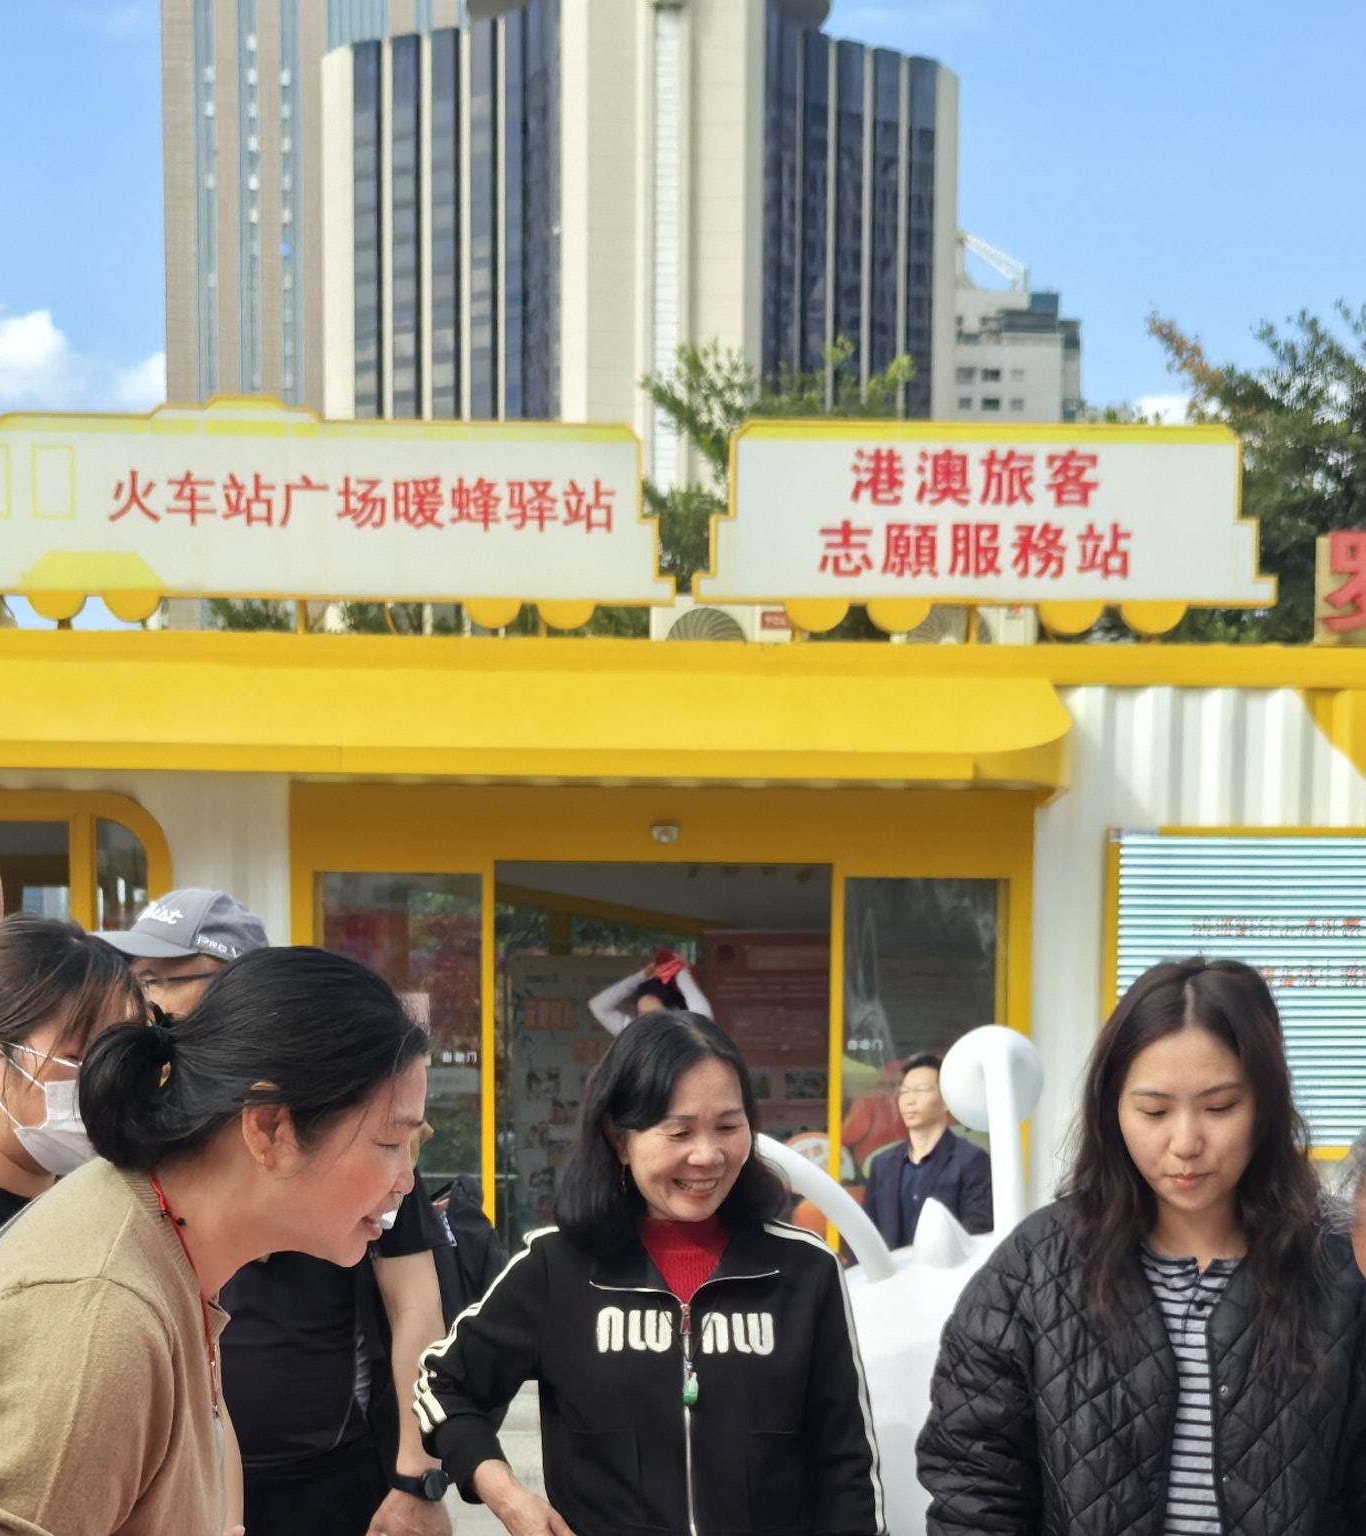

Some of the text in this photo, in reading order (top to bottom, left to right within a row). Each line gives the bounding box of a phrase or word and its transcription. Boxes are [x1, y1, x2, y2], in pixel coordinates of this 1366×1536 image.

[108, 469, 616, 534] 火车站广场暖蜂驿站
[850, 448, 1101, 508] 港澳旅客
[818, 520, 1133, 579] 志願服務站
